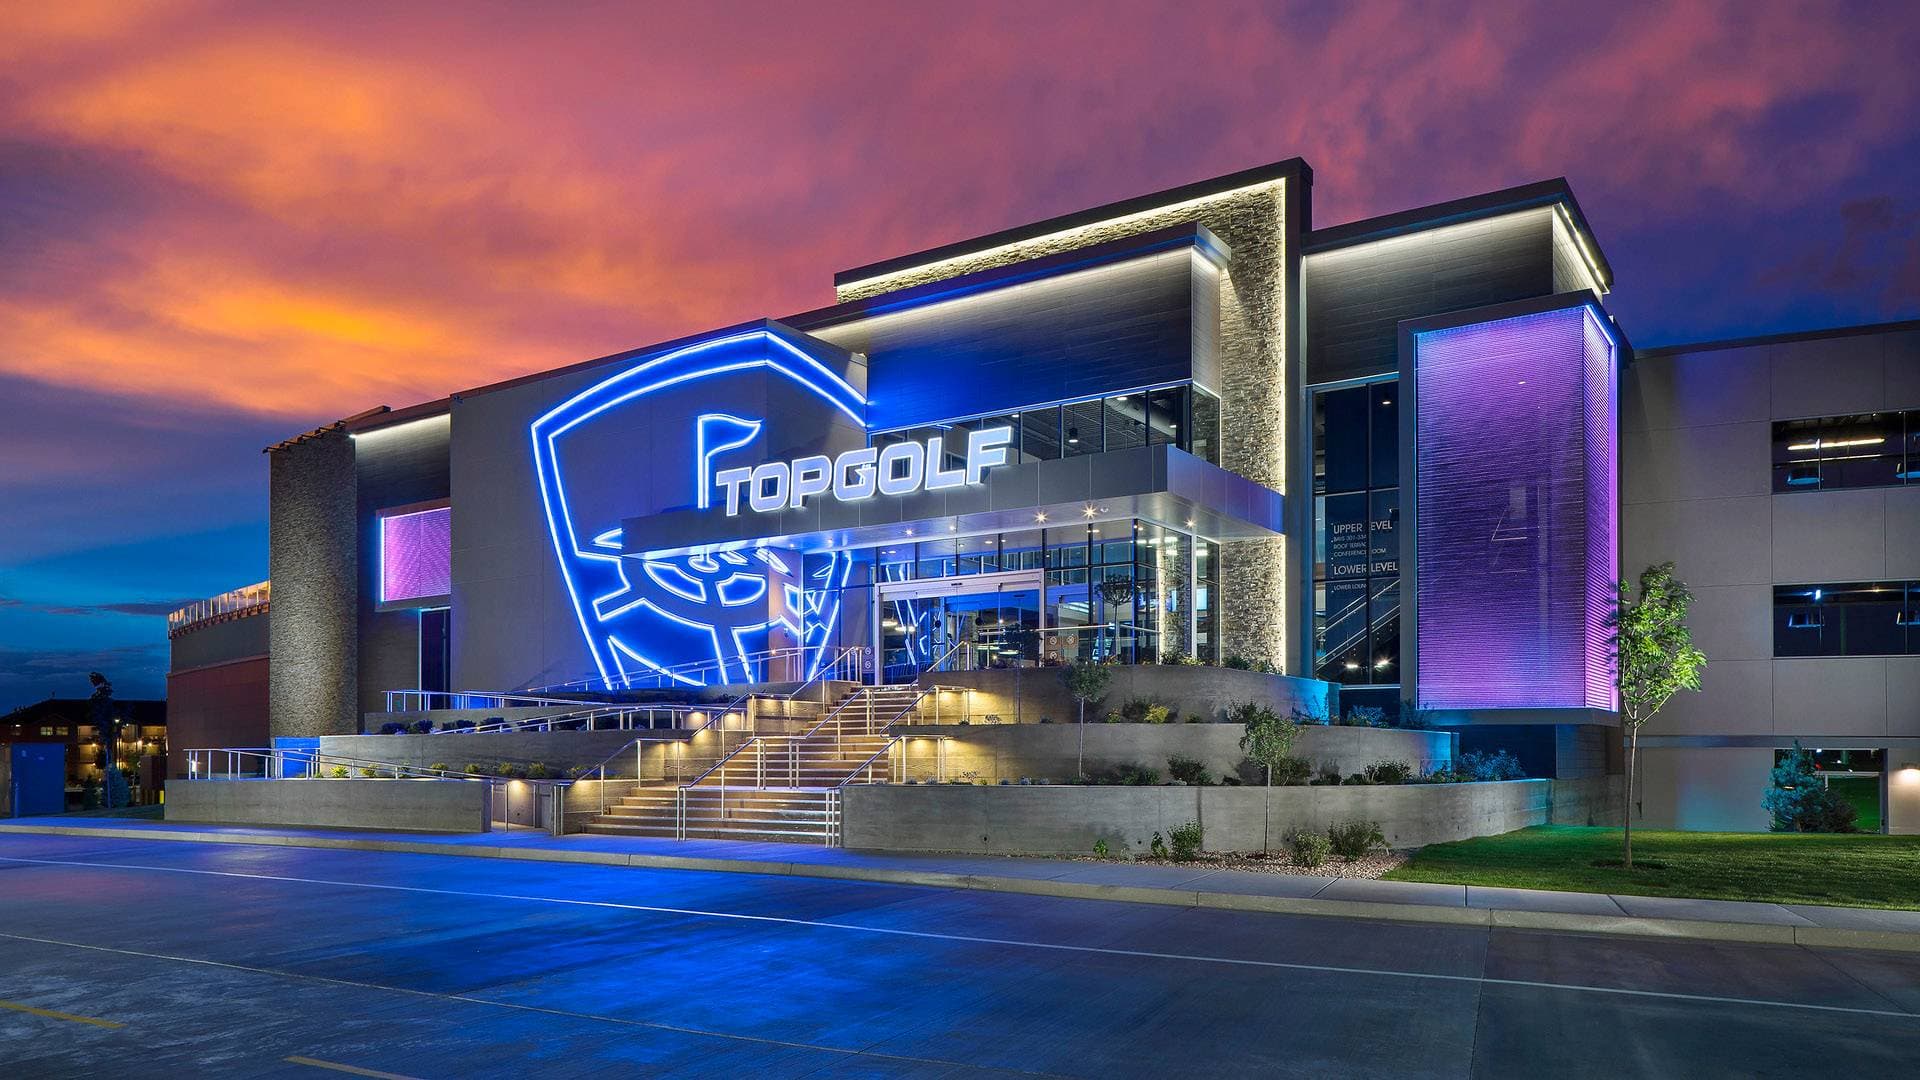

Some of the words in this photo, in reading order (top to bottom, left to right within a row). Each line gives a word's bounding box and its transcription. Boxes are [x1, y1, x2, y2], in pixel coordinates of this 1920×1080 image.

[716, 426, 1012, 517] TOPGOLF
[1334, 523, 1363, 534] UPPER
[1370, 520, 1393, 531] EVEL
[1334, 564, 1367, 575] LOWER
[1371, 561, 1398, 572] LEVEL
